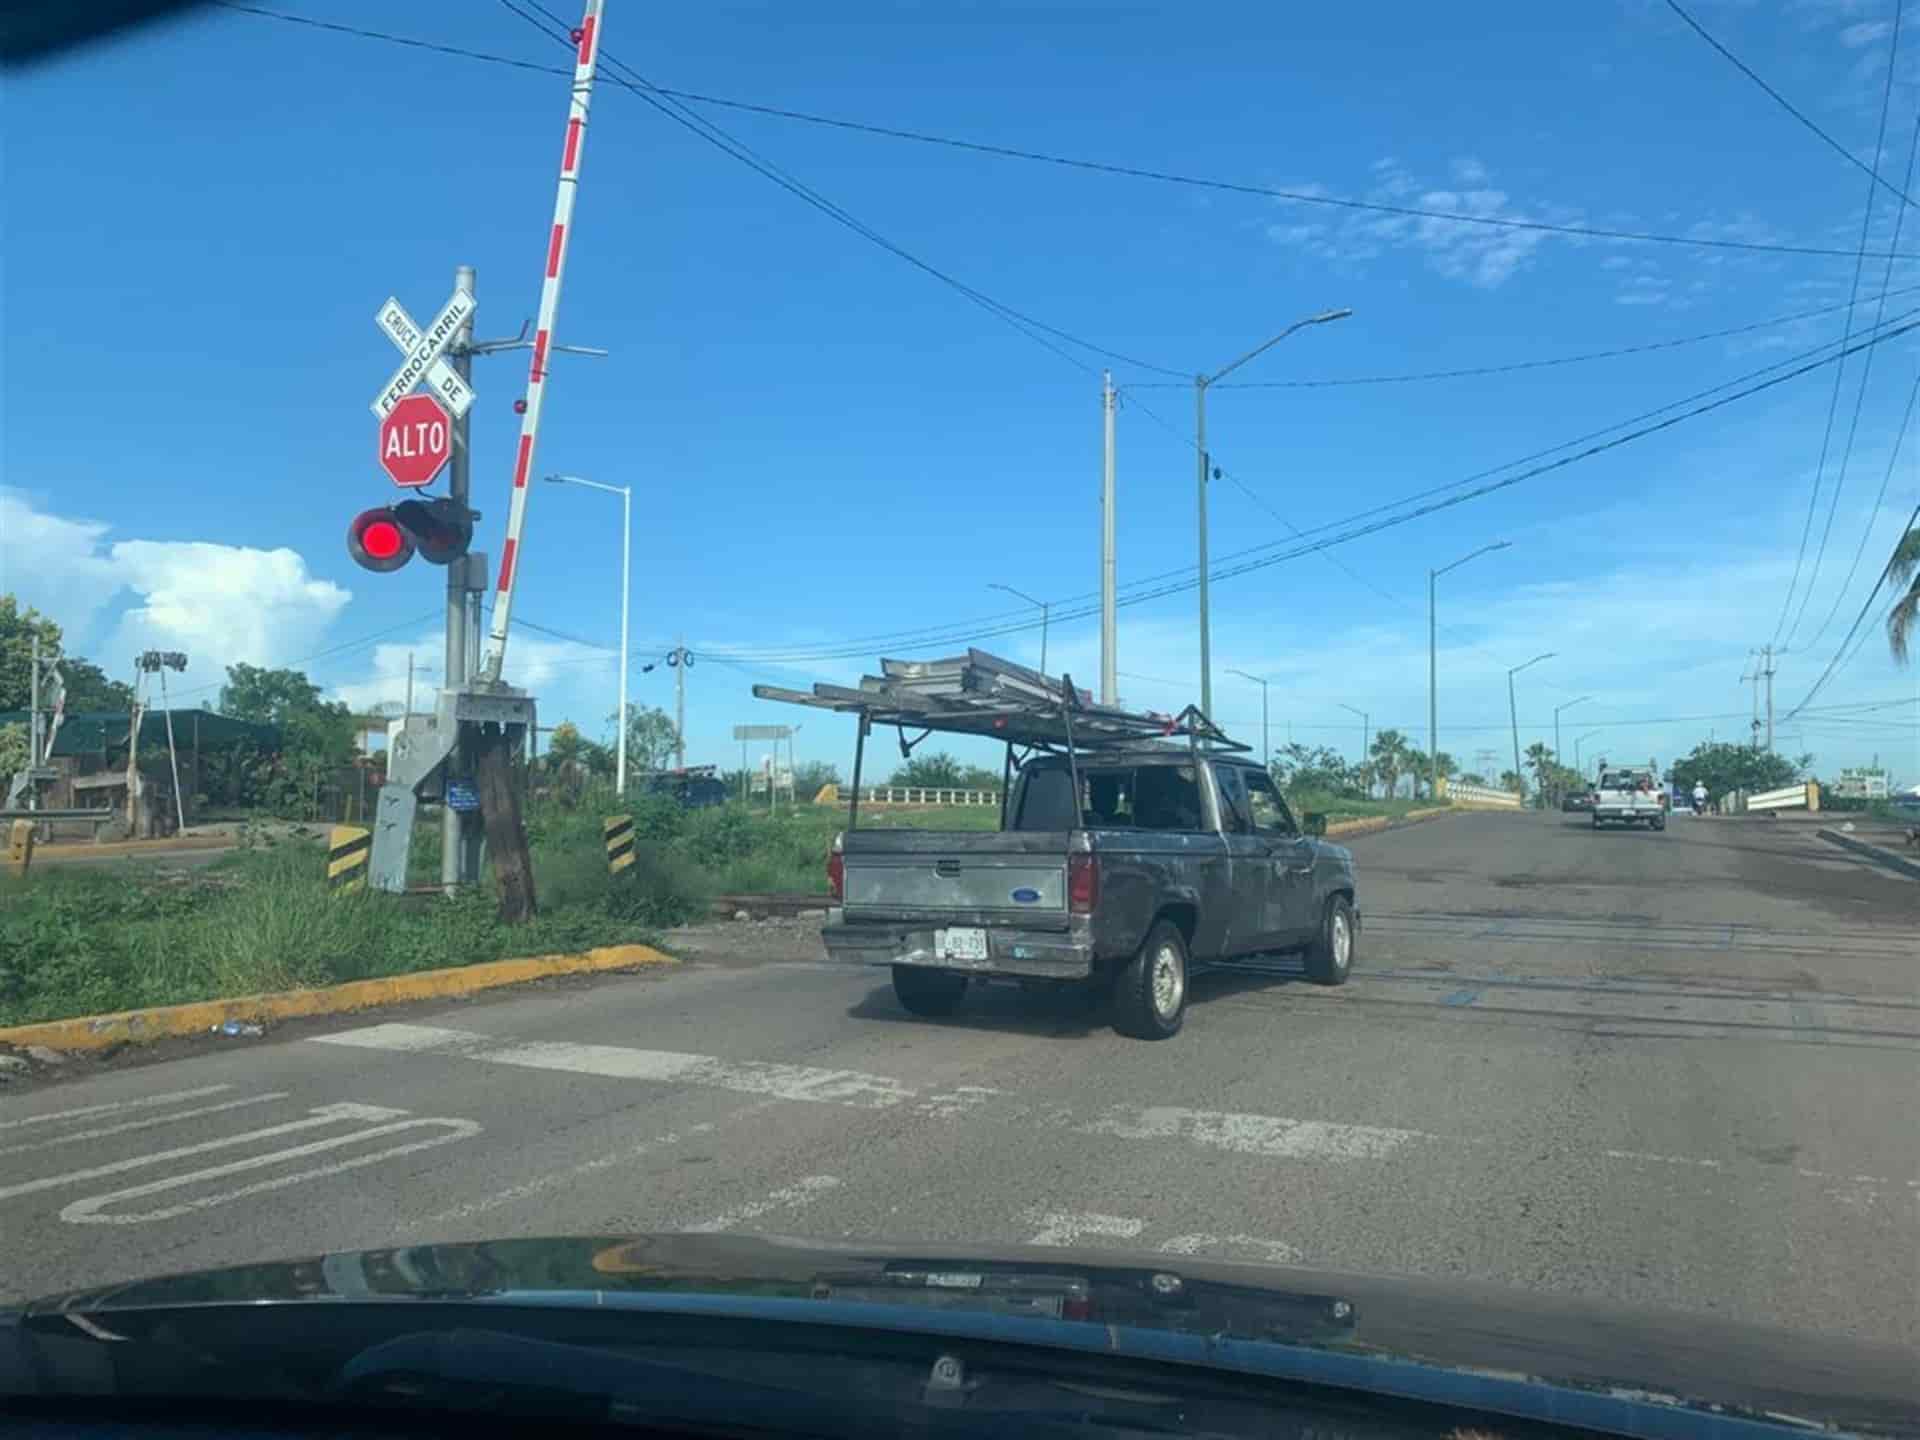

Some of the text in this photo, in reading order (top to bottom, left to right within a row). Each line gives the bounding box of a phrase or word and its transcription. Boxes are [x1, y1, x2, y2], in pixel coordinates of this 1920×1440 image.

[381, 304, 467, 413] FERROCARRIL
[385, 310, 463, 403] CRUCE DE
[385, 421, 445, 460] ALTO
